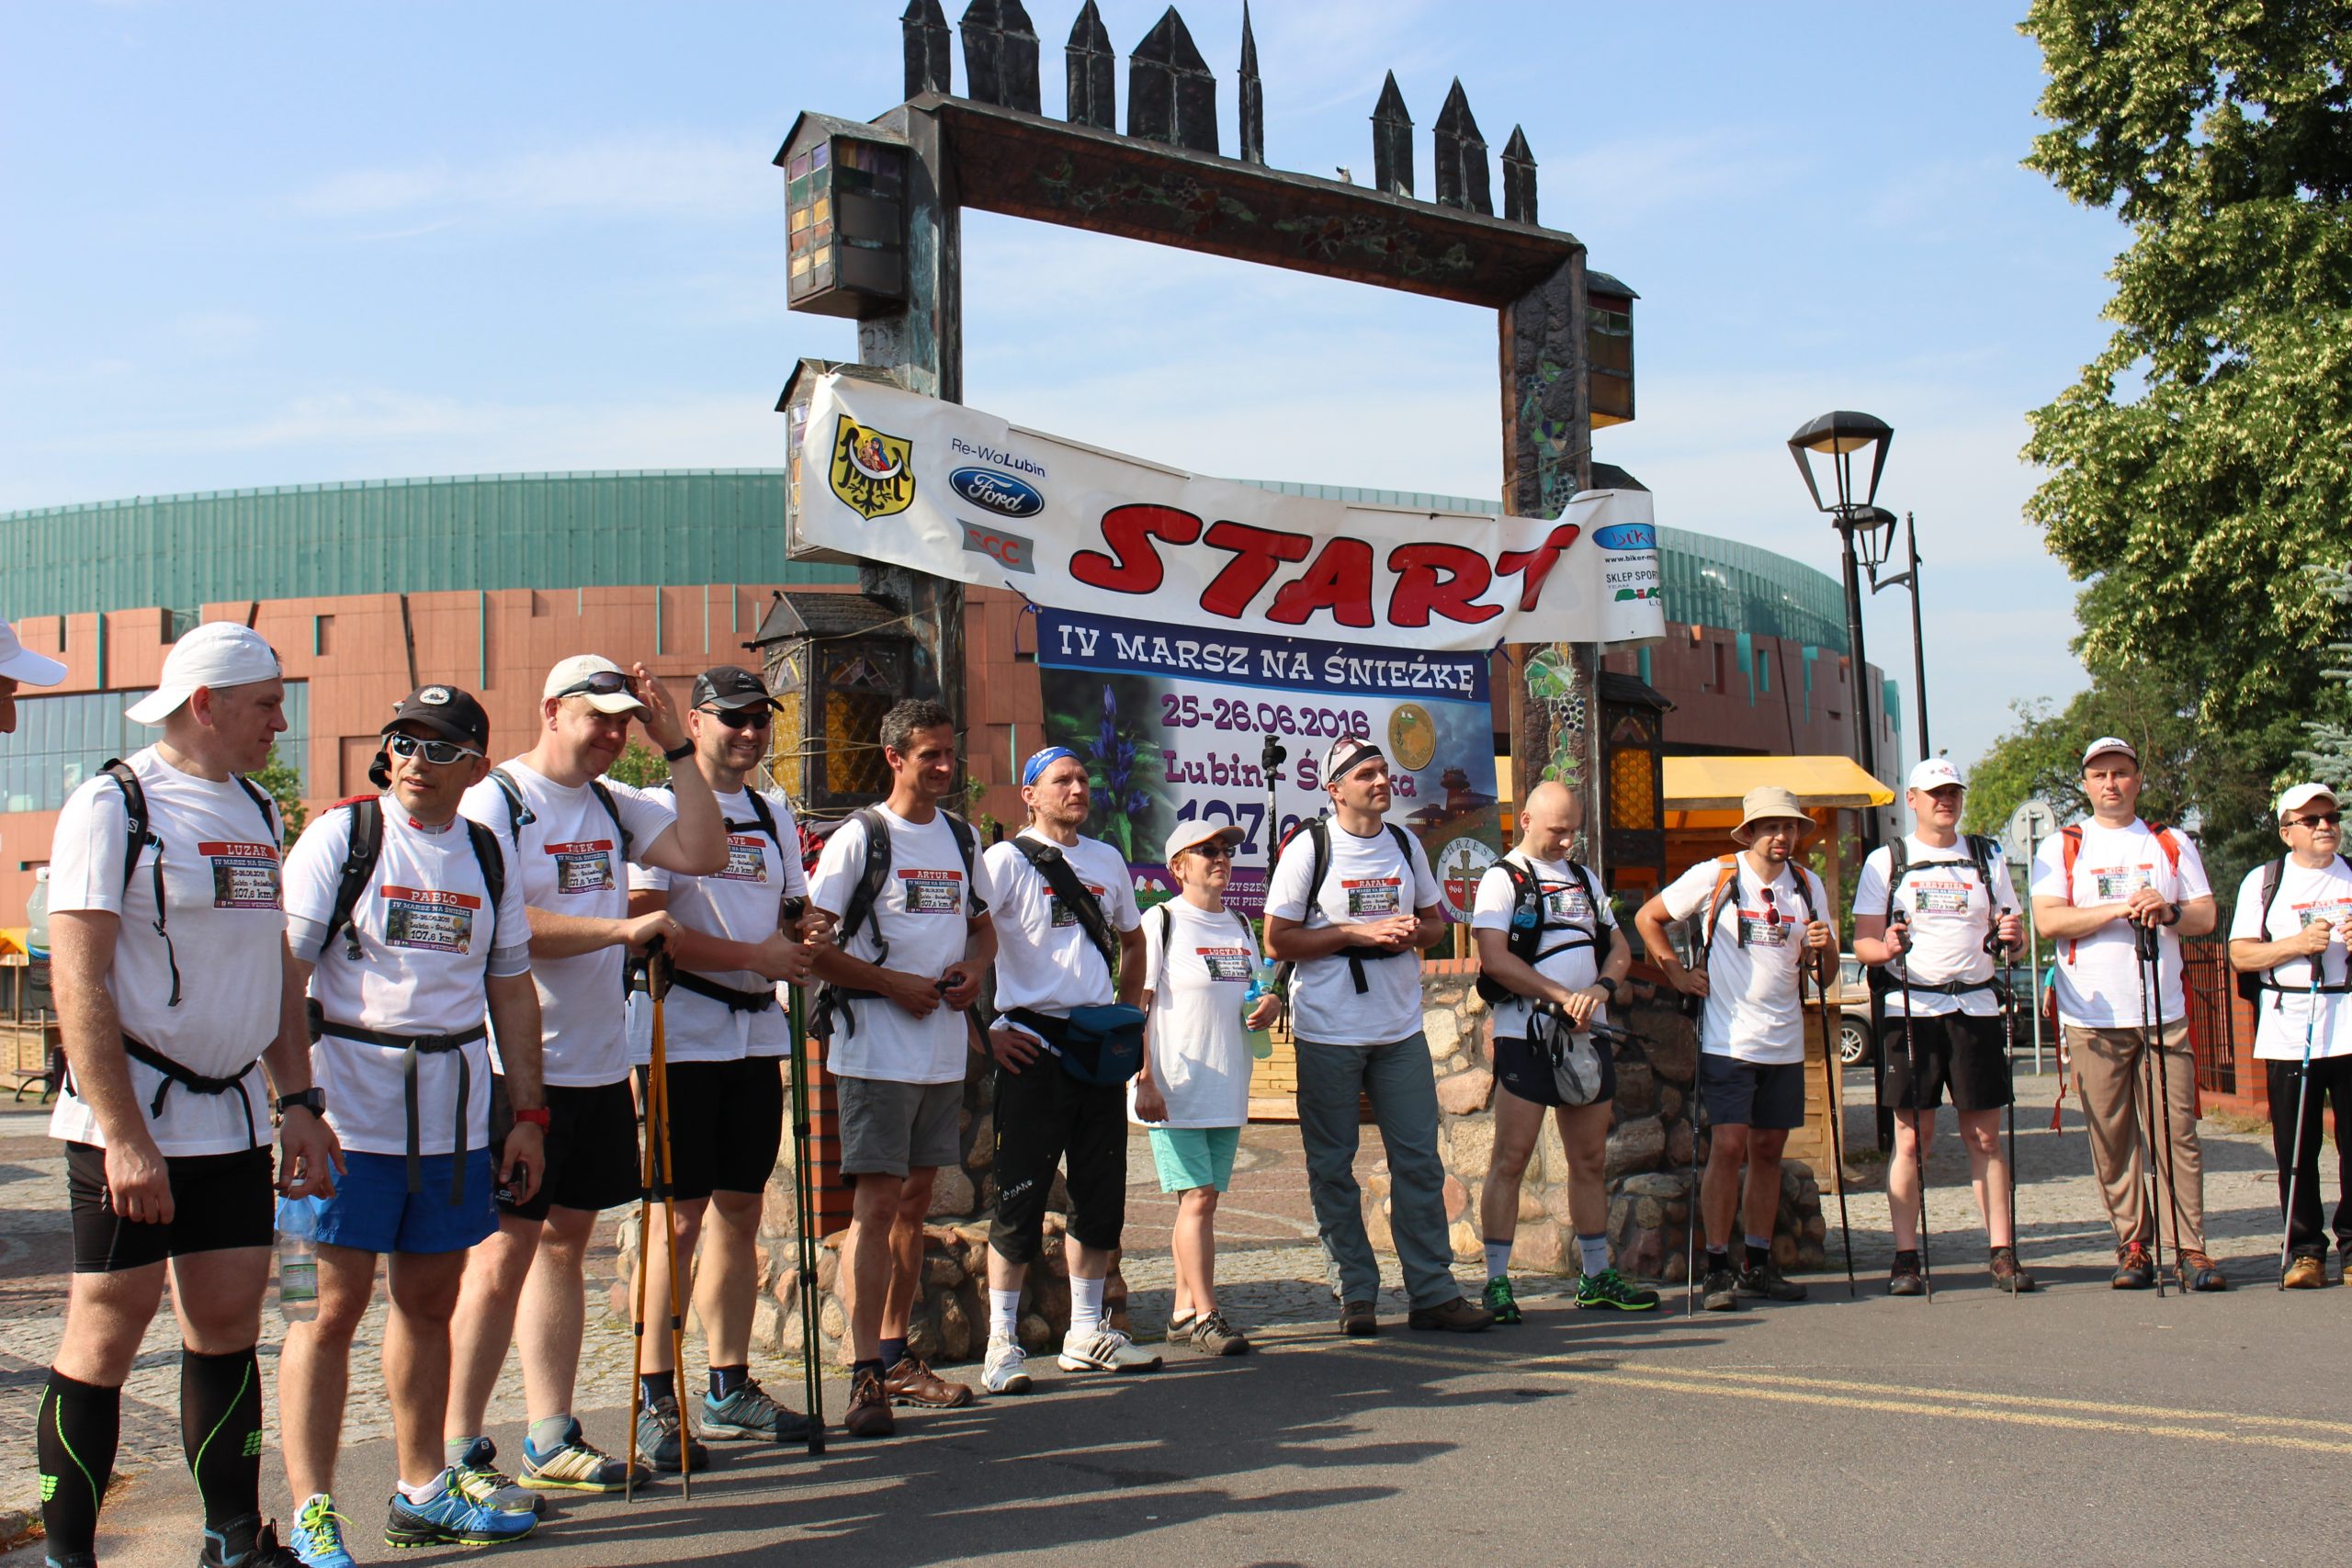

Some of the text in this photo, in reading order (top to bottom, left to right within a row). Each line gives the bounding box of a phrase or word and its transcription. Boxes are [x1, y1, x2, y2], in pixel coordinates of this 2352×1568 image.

[951, 437, 1046, 478] Re-WoLubin
[967, 472, 1027, 513] Ford
[1069, 502, 1581, 629] START
[1606, 571, 1633, 584] SKLEP
[1057, 625, 1475, 699] IV MARSZ NA ŚNIEŻKĘ
[1160, 693, 1371, 740] 25-26.06.2016
[1162, 749, 1264, 788] Lubin
[727, 836, 746, 845] AVE
[226, 844, 268, 857] LUZAK
[917, 871, 949, 880] ARTUR
[256, 888, 273, 899] km
[1449, 886, 1463, 894] 966
[411, 891, 458, 905] PABLO
[403, 903, 431, 912] MARSZ
[439, 932, 453, 943] km
